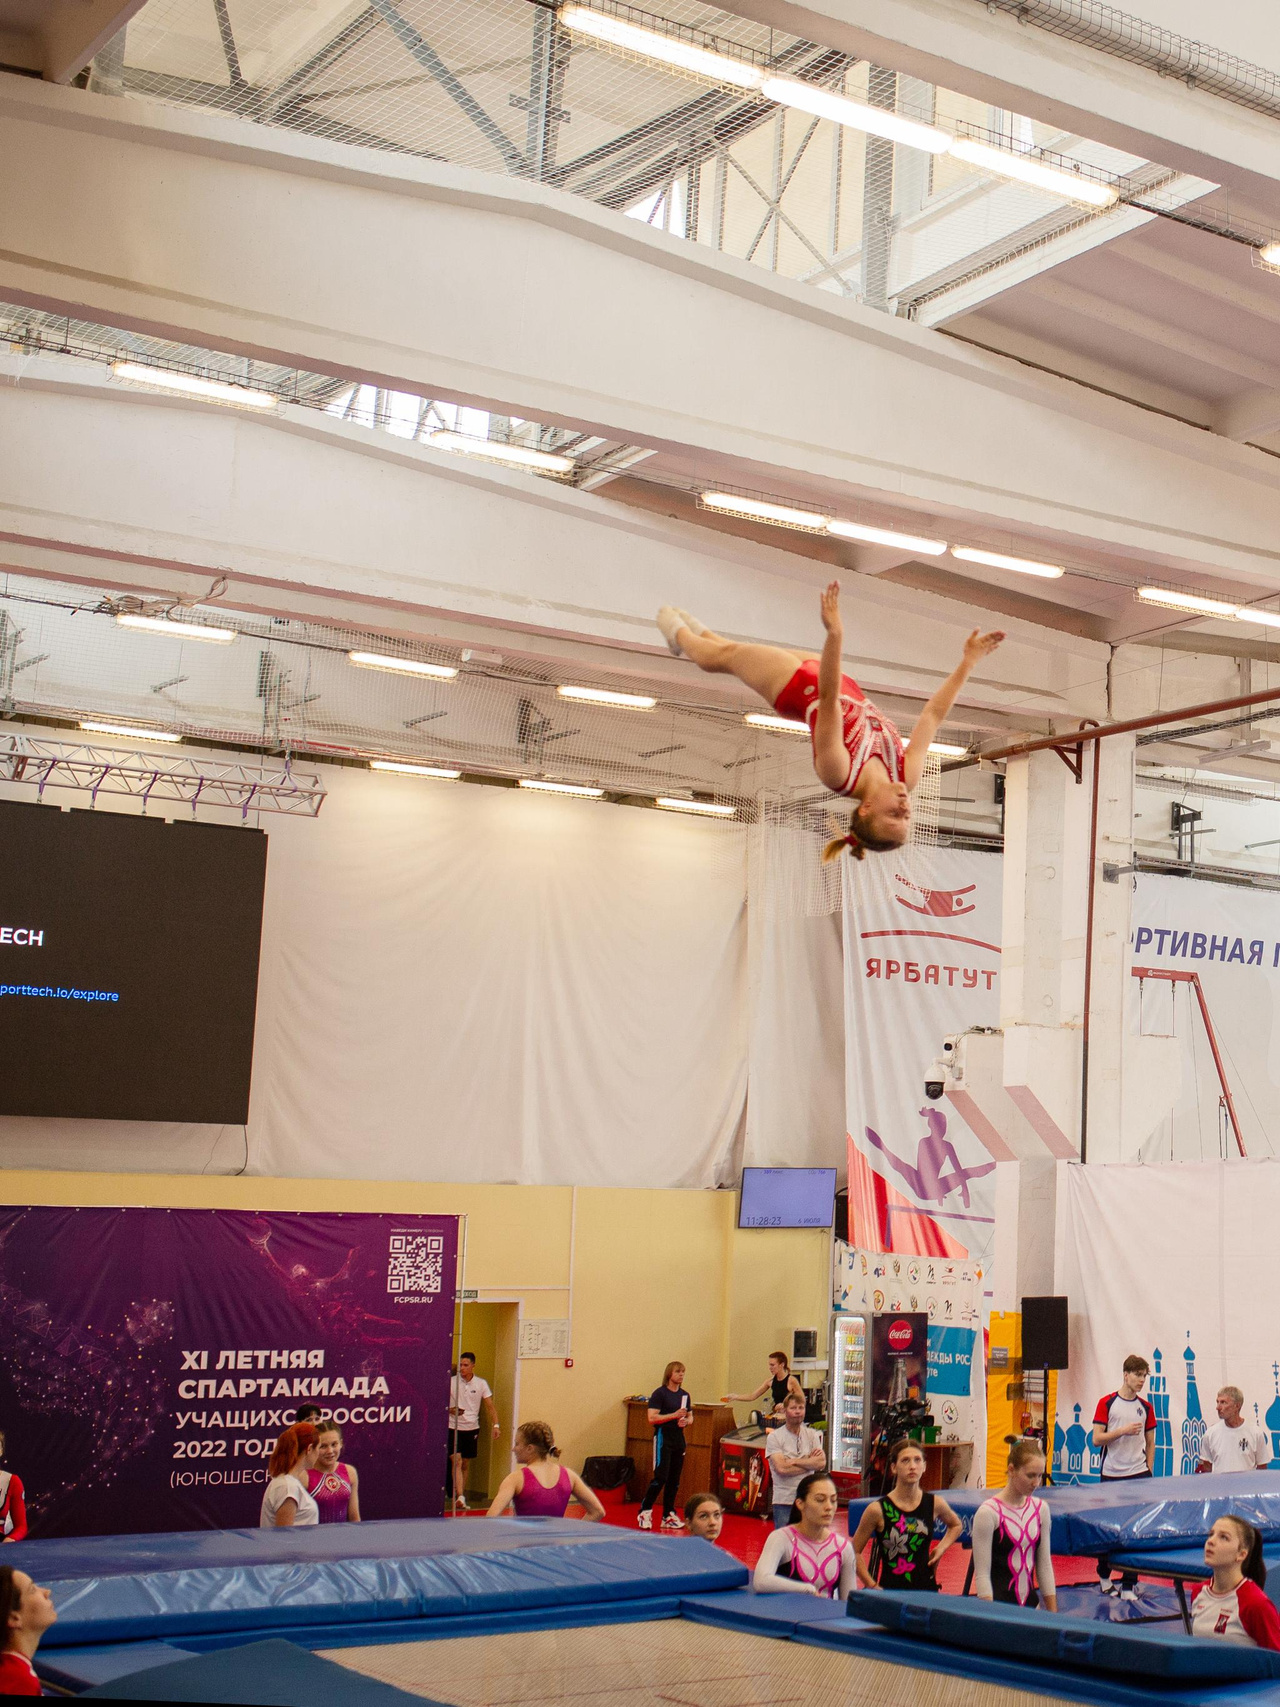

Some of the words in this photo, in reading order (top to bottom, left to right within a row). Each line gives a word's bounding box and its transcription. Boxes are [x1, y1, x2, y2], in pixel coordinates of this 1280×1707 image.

[1131, 926, 1265, 966] РТИВНАЯ
[865, 957, 998, 991] ЯРБАТУТ
[0, 984, 119, 1002] porttech.io/explore
[746, 1216, 782, 1226] 11:28:23
[393, 1296, 433, 1304] FCPSR.RU
[180, 1351, 208, 1370] XI
[215, 1349, 325, 1370] ЛЕТНЯЯ
[178, 1376, 390, 1400] СПАРТАКИАДА
[175, 1409, 297, 1430] УЧАЩИХС
[320, 1405, 412, 1424] РОССИИ
[172, 1440, 227, 1459] 2022
